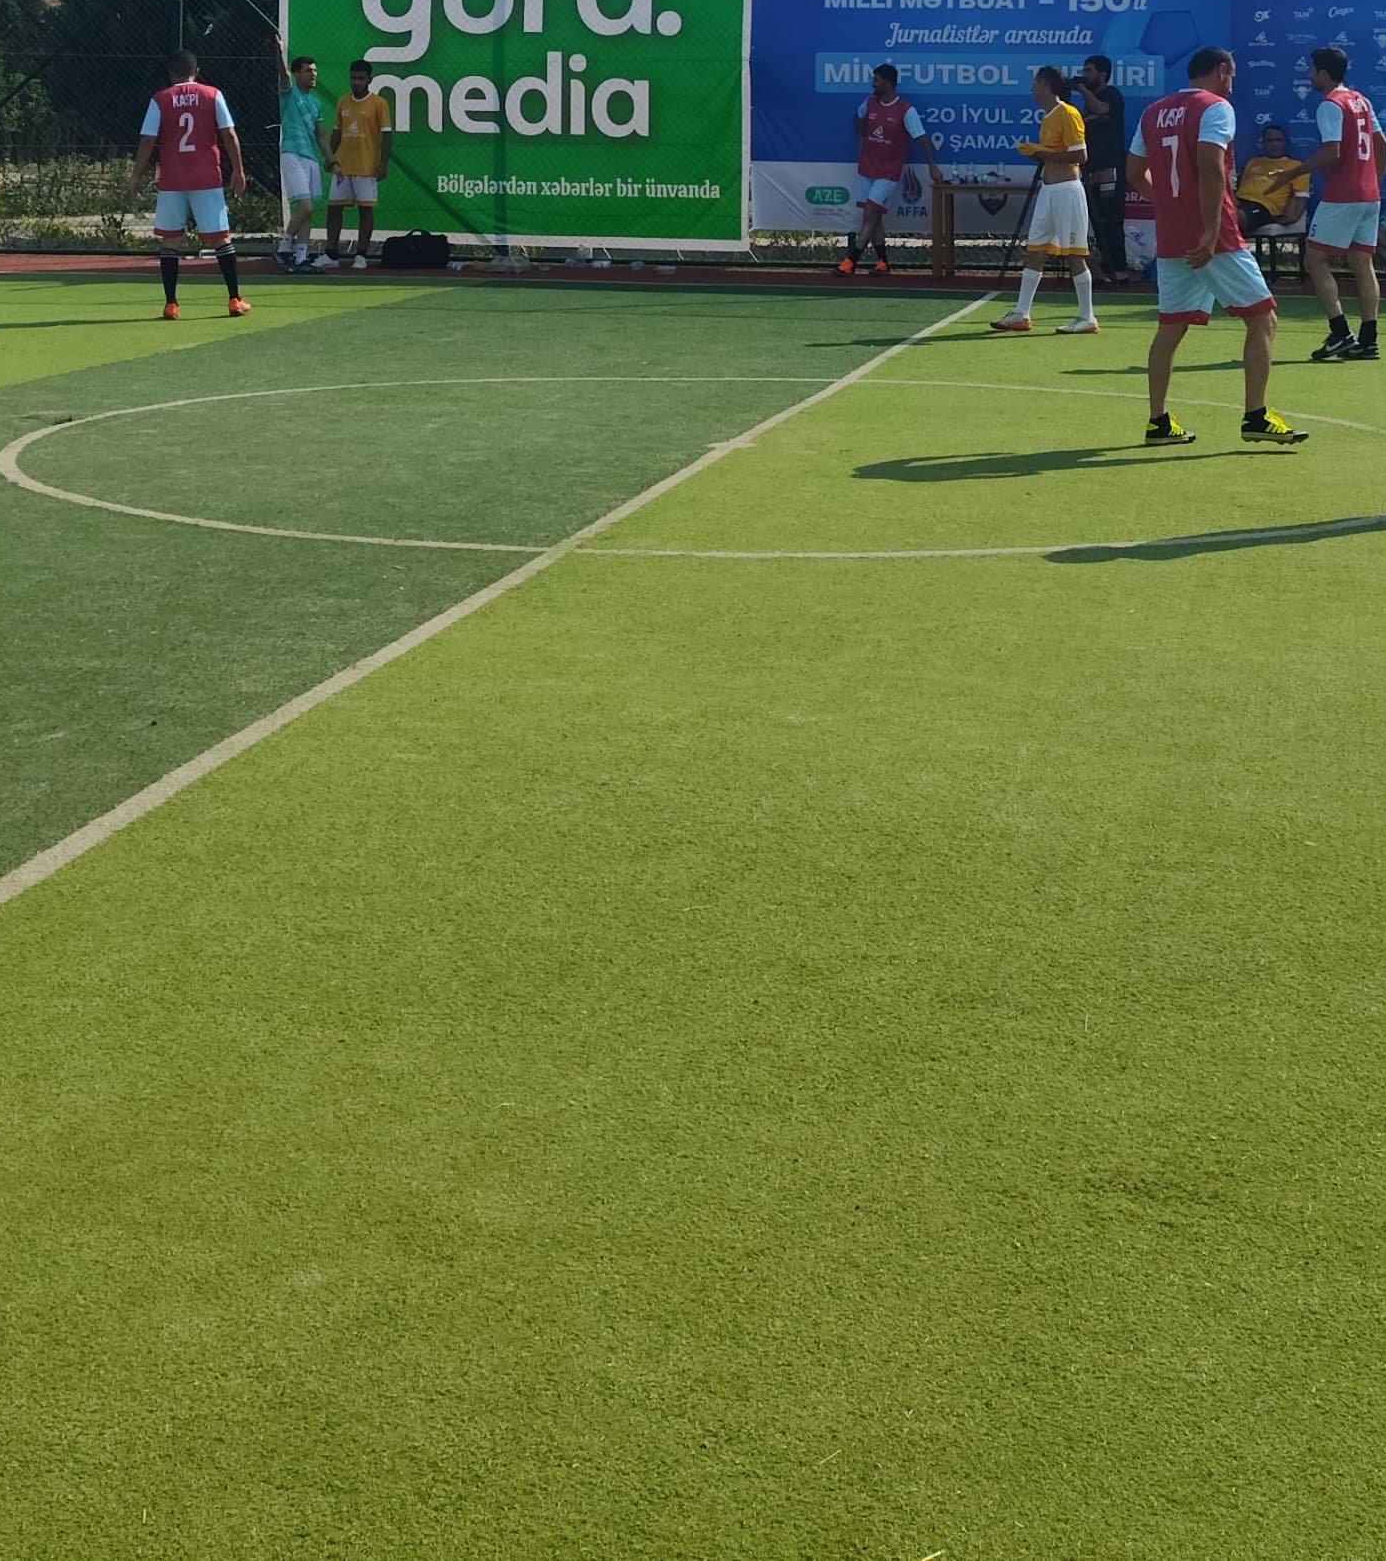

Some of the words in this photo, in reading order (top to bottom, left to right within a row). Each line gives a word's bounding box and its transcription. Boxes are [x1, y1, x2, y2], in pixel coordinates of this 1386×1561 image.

[885, 22, 998, 47] Jurnalistlər
[1004, 25, 1093, 45] arasında
[367, 51, 650, 138] media
[962, 103, 1014, 124] İYUL
[178, 112, 196, 153] 2
[1357, 118, 1370, 161] 5
[1162, 135, 1180, 198] 7
[437, 175, 538, 199] Bölgələrdən
[541, 177, 613, 198] xəbərlər
[616, 178, 642, 198] bir
[645, 179, 720, 199] ünvanda
[813, 189, 842, 203] AZE
[896, 206, 928, 217] AFFA
